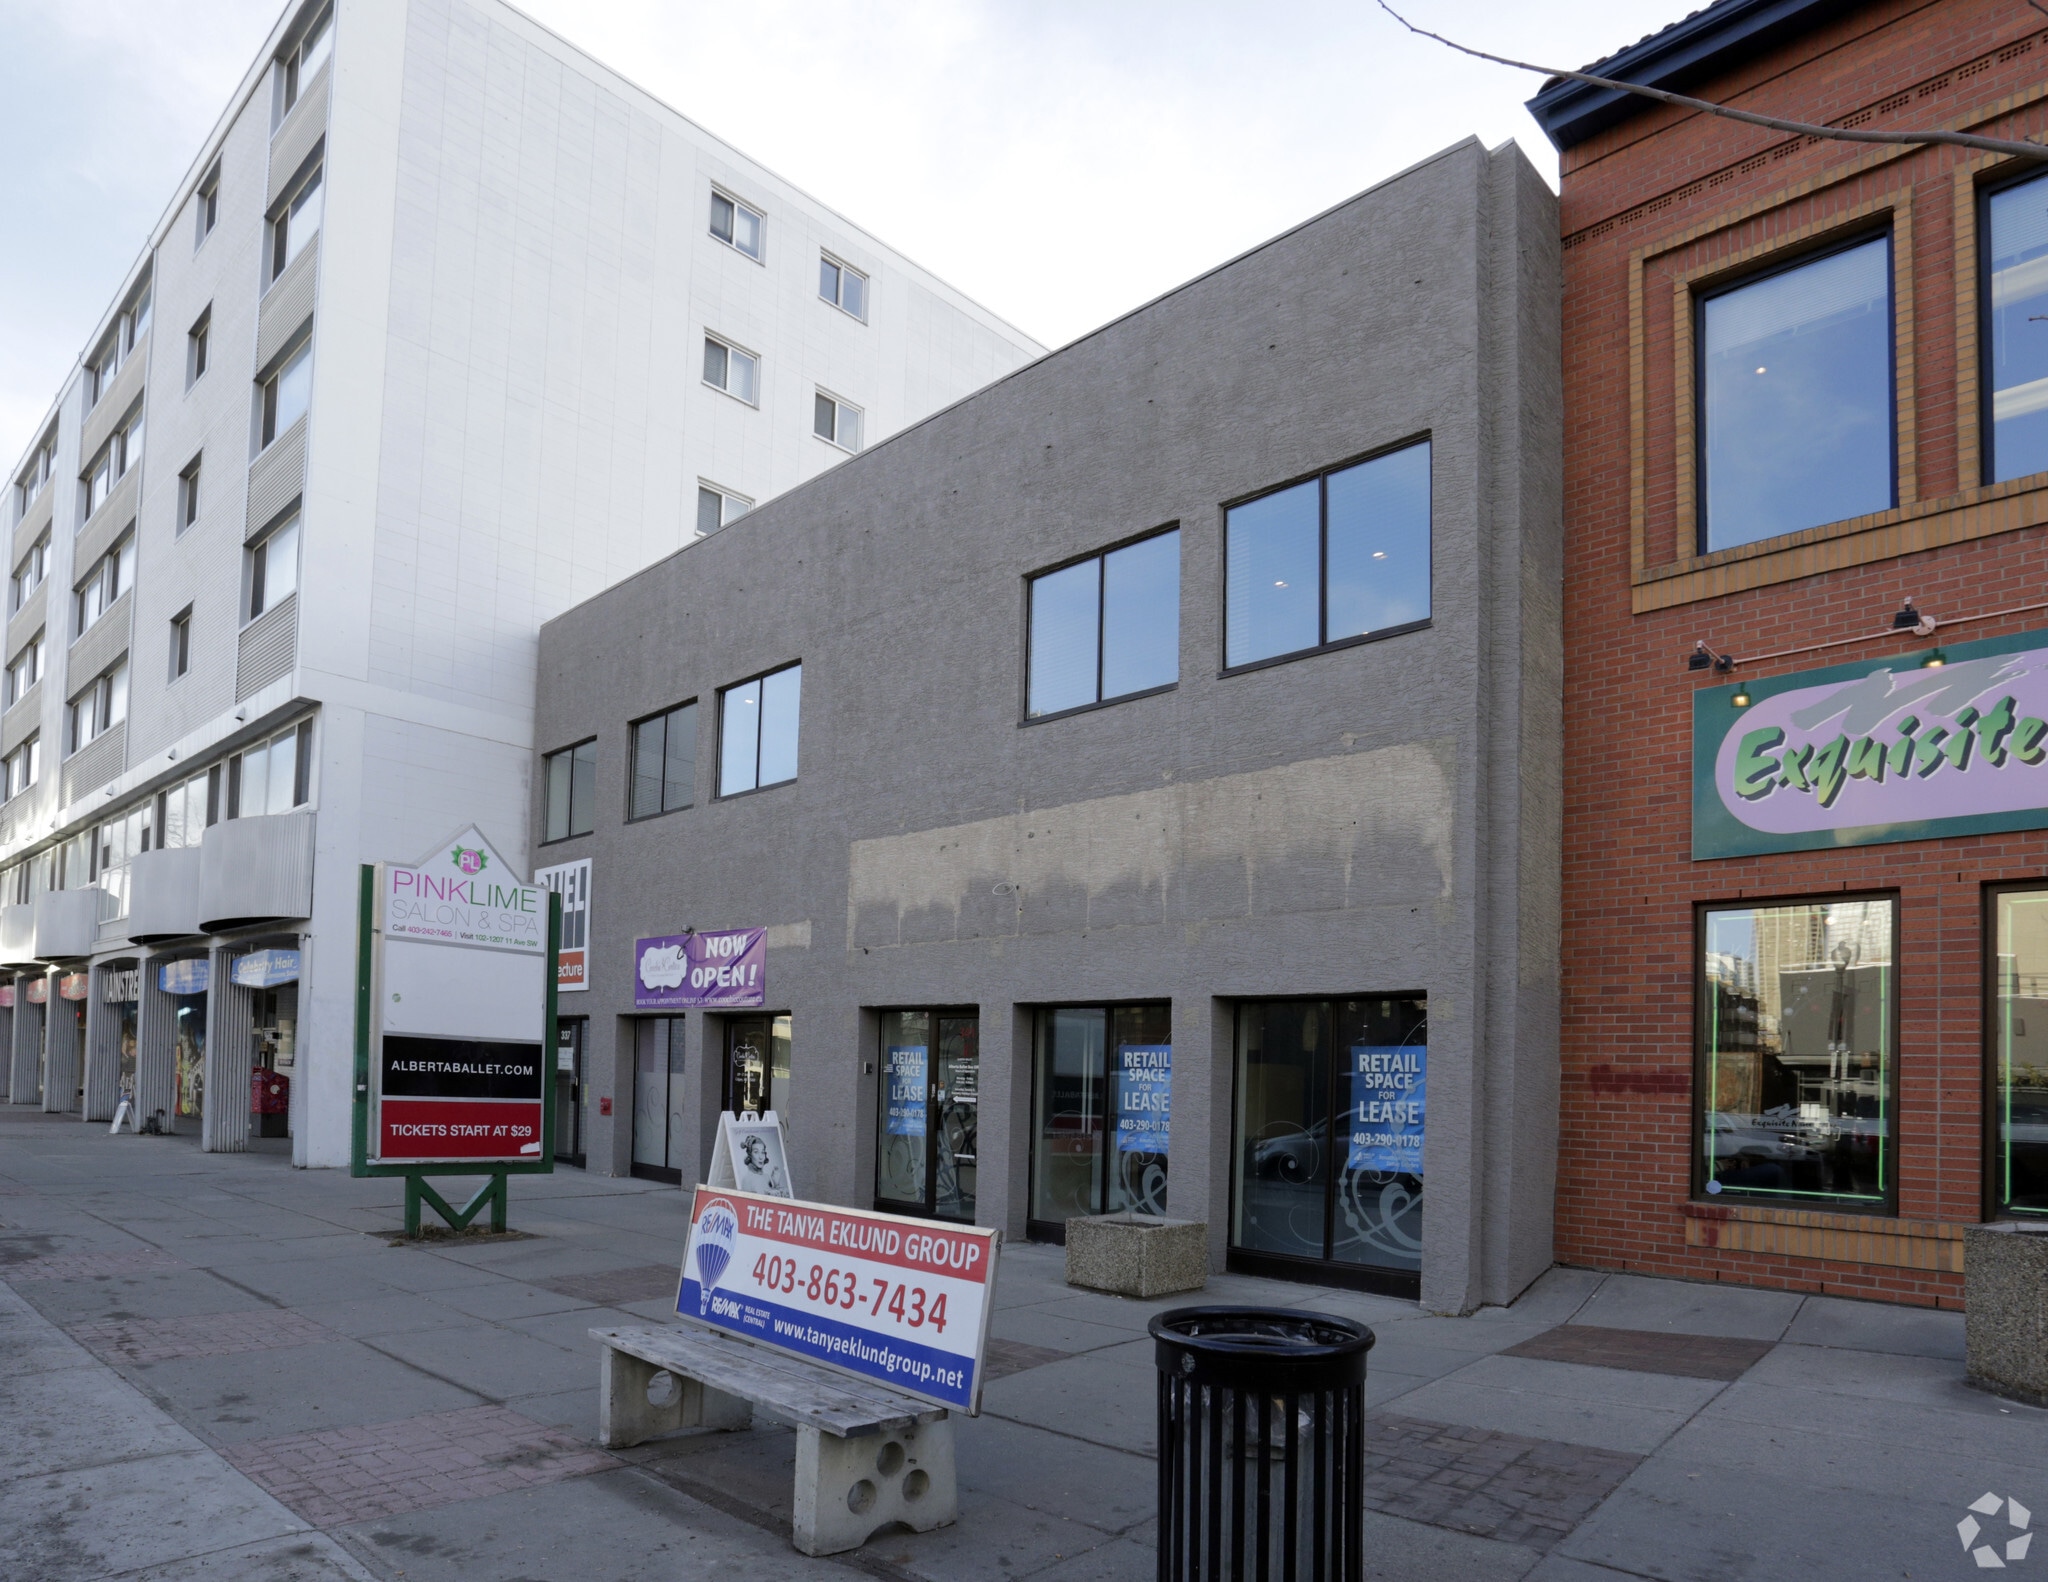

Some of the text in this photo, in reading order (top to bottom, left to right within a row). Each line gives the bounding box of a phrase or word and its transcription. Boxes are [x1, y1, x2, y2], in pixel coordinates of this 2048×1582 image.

[1734, 695, 2047, 809] Exquisite
[460, 854, 479, 870] PL
[391, 899, 539, 935] SALON & SPA
[392, 923, 538, 947] Call 403-242-7465 Visit 102-1207 11 Ave SW
[705, 935, 748, 958] NOW
[274, 955, 295, 970] Hair
[691, 964, 758, 989] OPEN!
[560, 1030, 571, 1040] 337
[892, 1052, 924, 1065] RETAIL
[1124, 1052, 1171, 1068] RETAIL
[1359, 1054, 1421, 1073] RETAIL
[391, 1060, 533, 1076] ALBERTABALLET.COM
[896, 1066, 921, 1077] SPACE
[1129, 1068, 1166, 1082] SPACE
[1138, 1083, 1152, 1091] FOR
[1365, 1073, 1413, 1089] SPACE
[892, 1085, 924, 1102] LEASE
[1378, 1091, 1396, 1100] FOR
[1124, 1092, 1170, 1112] LEASE
[1359, 1101, 1419, 1124] LEASE
[390, 1124, 532, 1138] TICKETS START AT $29
[1120, 1119, 1170, 1131] 403-290-0178
[1353, 1132, 1420, 1147] 403-290-0178
[701, 1213, 735, 1240] RE/MAX
[746, 1205, 980, 1271] THE TANYA EKLUND GROUP
[752, 1252, 948, 1334] 403-863-7434
[745, 1305, 771, 1320] REAL ESTATE
[743, 1315, 765, 1329] (CENTRAL)
[773, 1319, 964, 1390] www.tanyaeklundgroup.net
